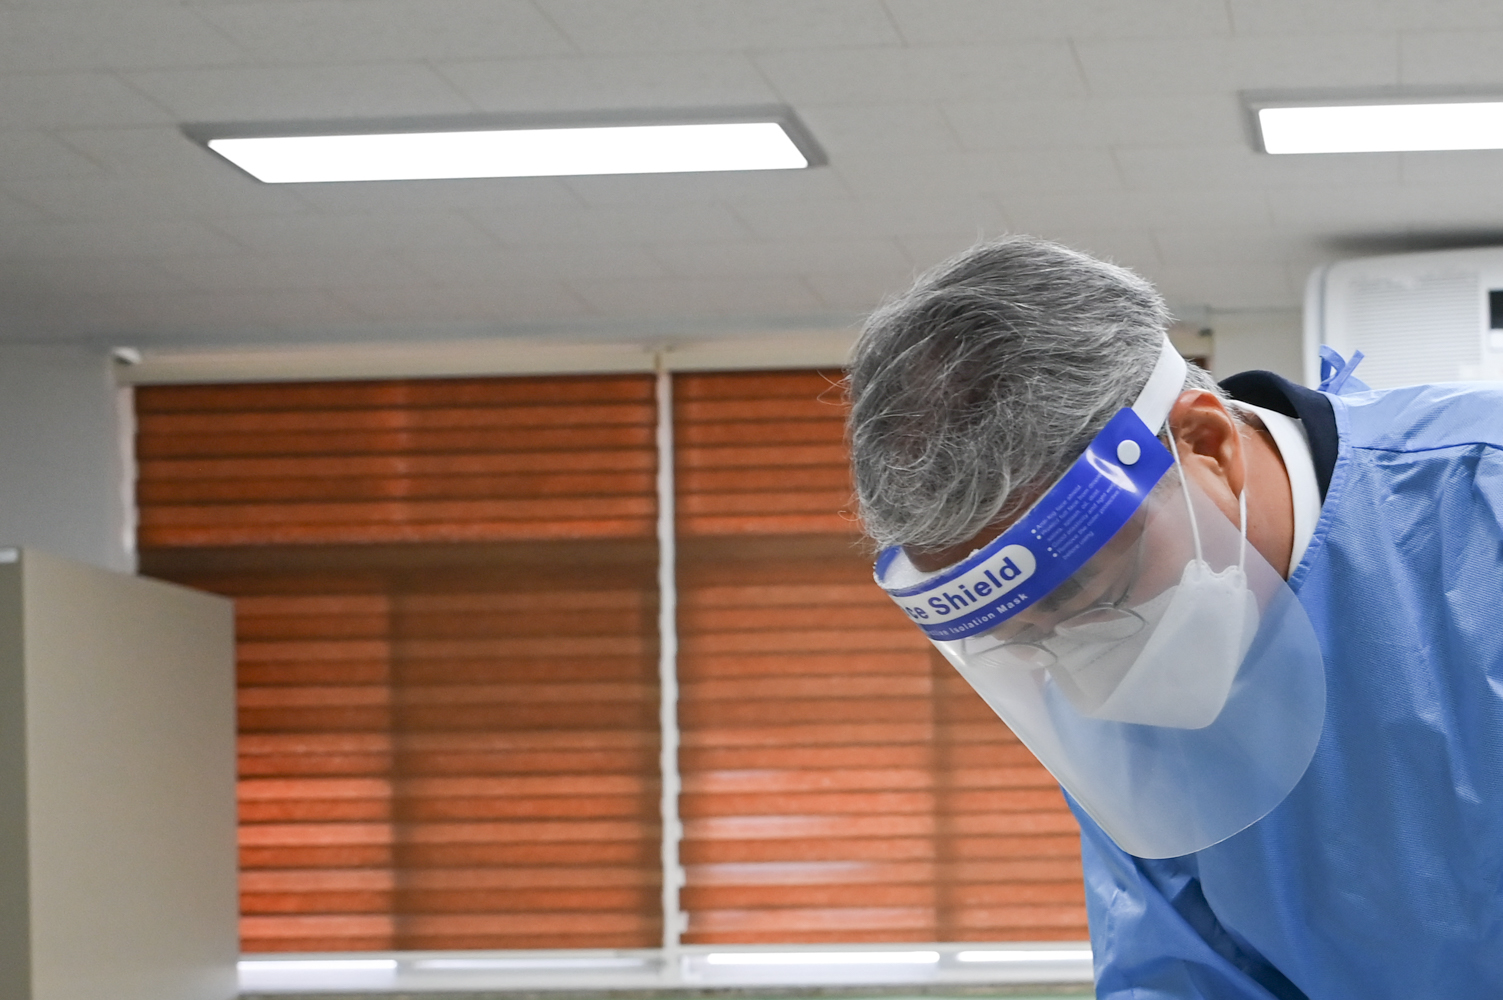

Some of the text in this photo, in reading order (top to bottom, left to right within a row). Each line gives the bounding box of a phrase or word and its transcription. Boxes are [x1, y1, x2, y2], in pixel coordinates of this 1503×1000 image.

[905, 557, 1022, 619] ce Shield
[949, 612, 996, 634] Isolation
[996, 592, 1028, 614] Mask
